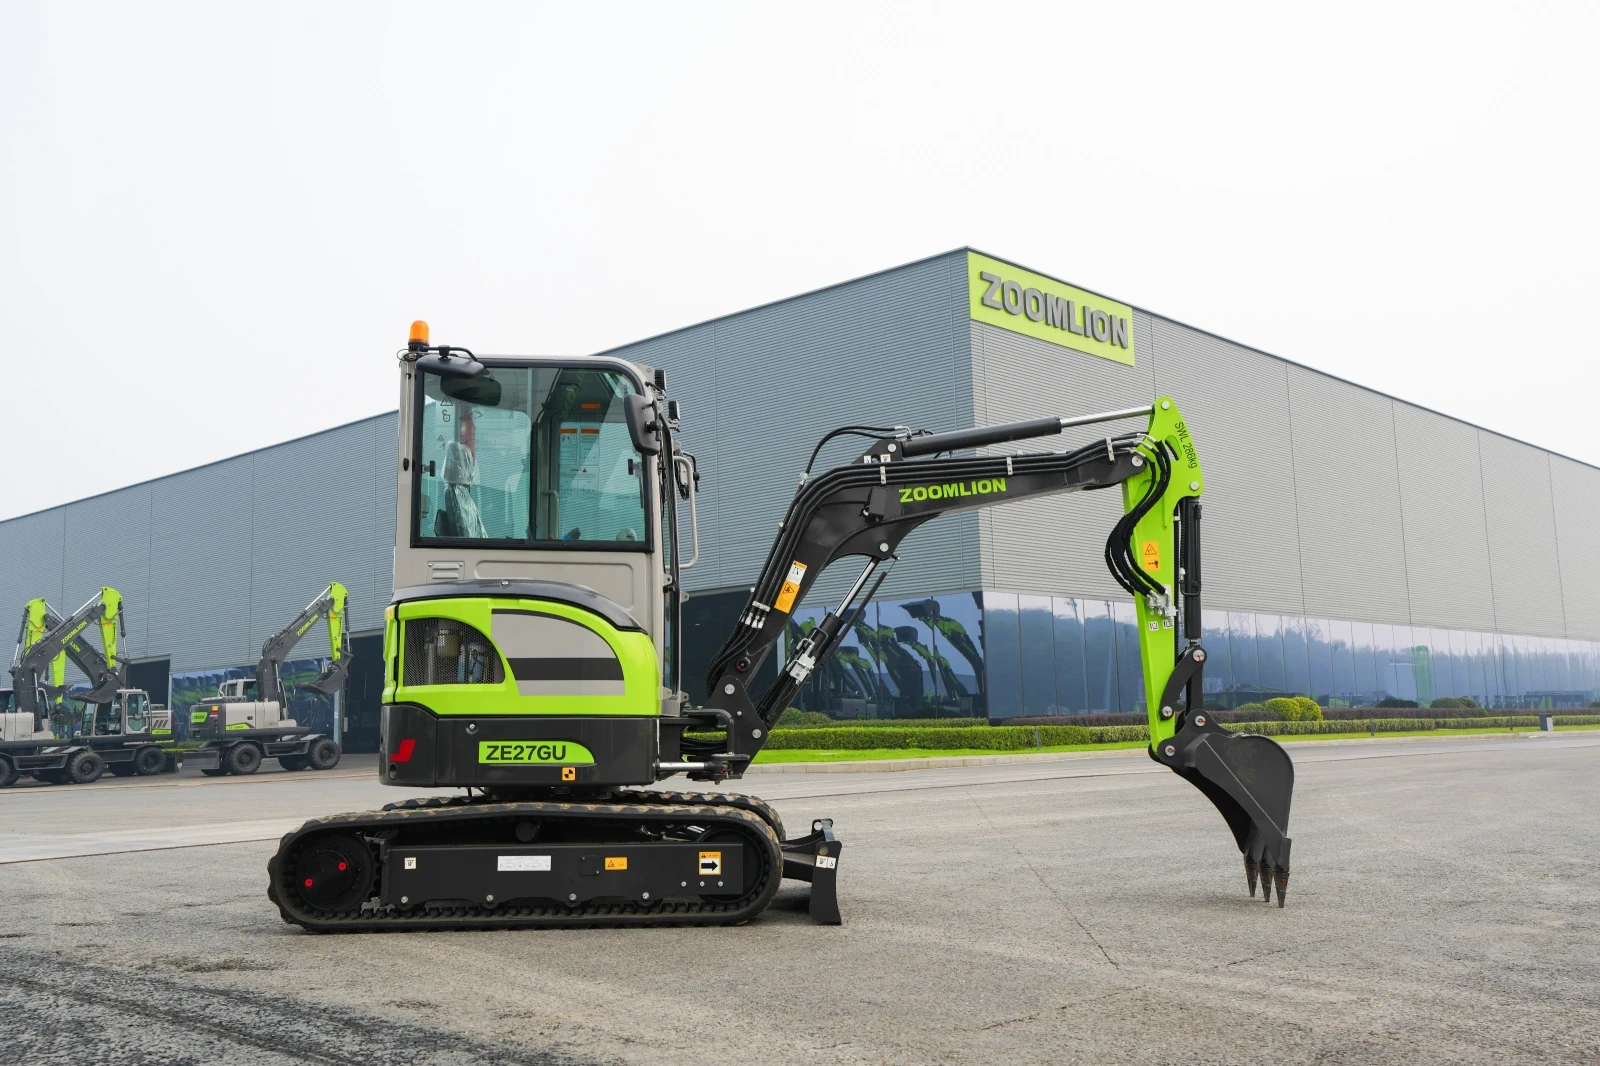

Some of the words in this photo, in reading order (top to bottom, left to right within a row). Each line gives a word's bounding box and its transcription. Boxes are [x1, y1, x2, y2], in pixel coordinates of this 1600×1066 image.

[980, 271, 1128, 349] ZOOMLION
[1175, 422, 1188, 442] SWL
[1183, 443, 1197, 469] 286kg
[899, 478, 1007, 503] ZOOMLION
[61, 620, 87, 644] ZOOMLION
[485, 745, 567, 761] ZE27GU
